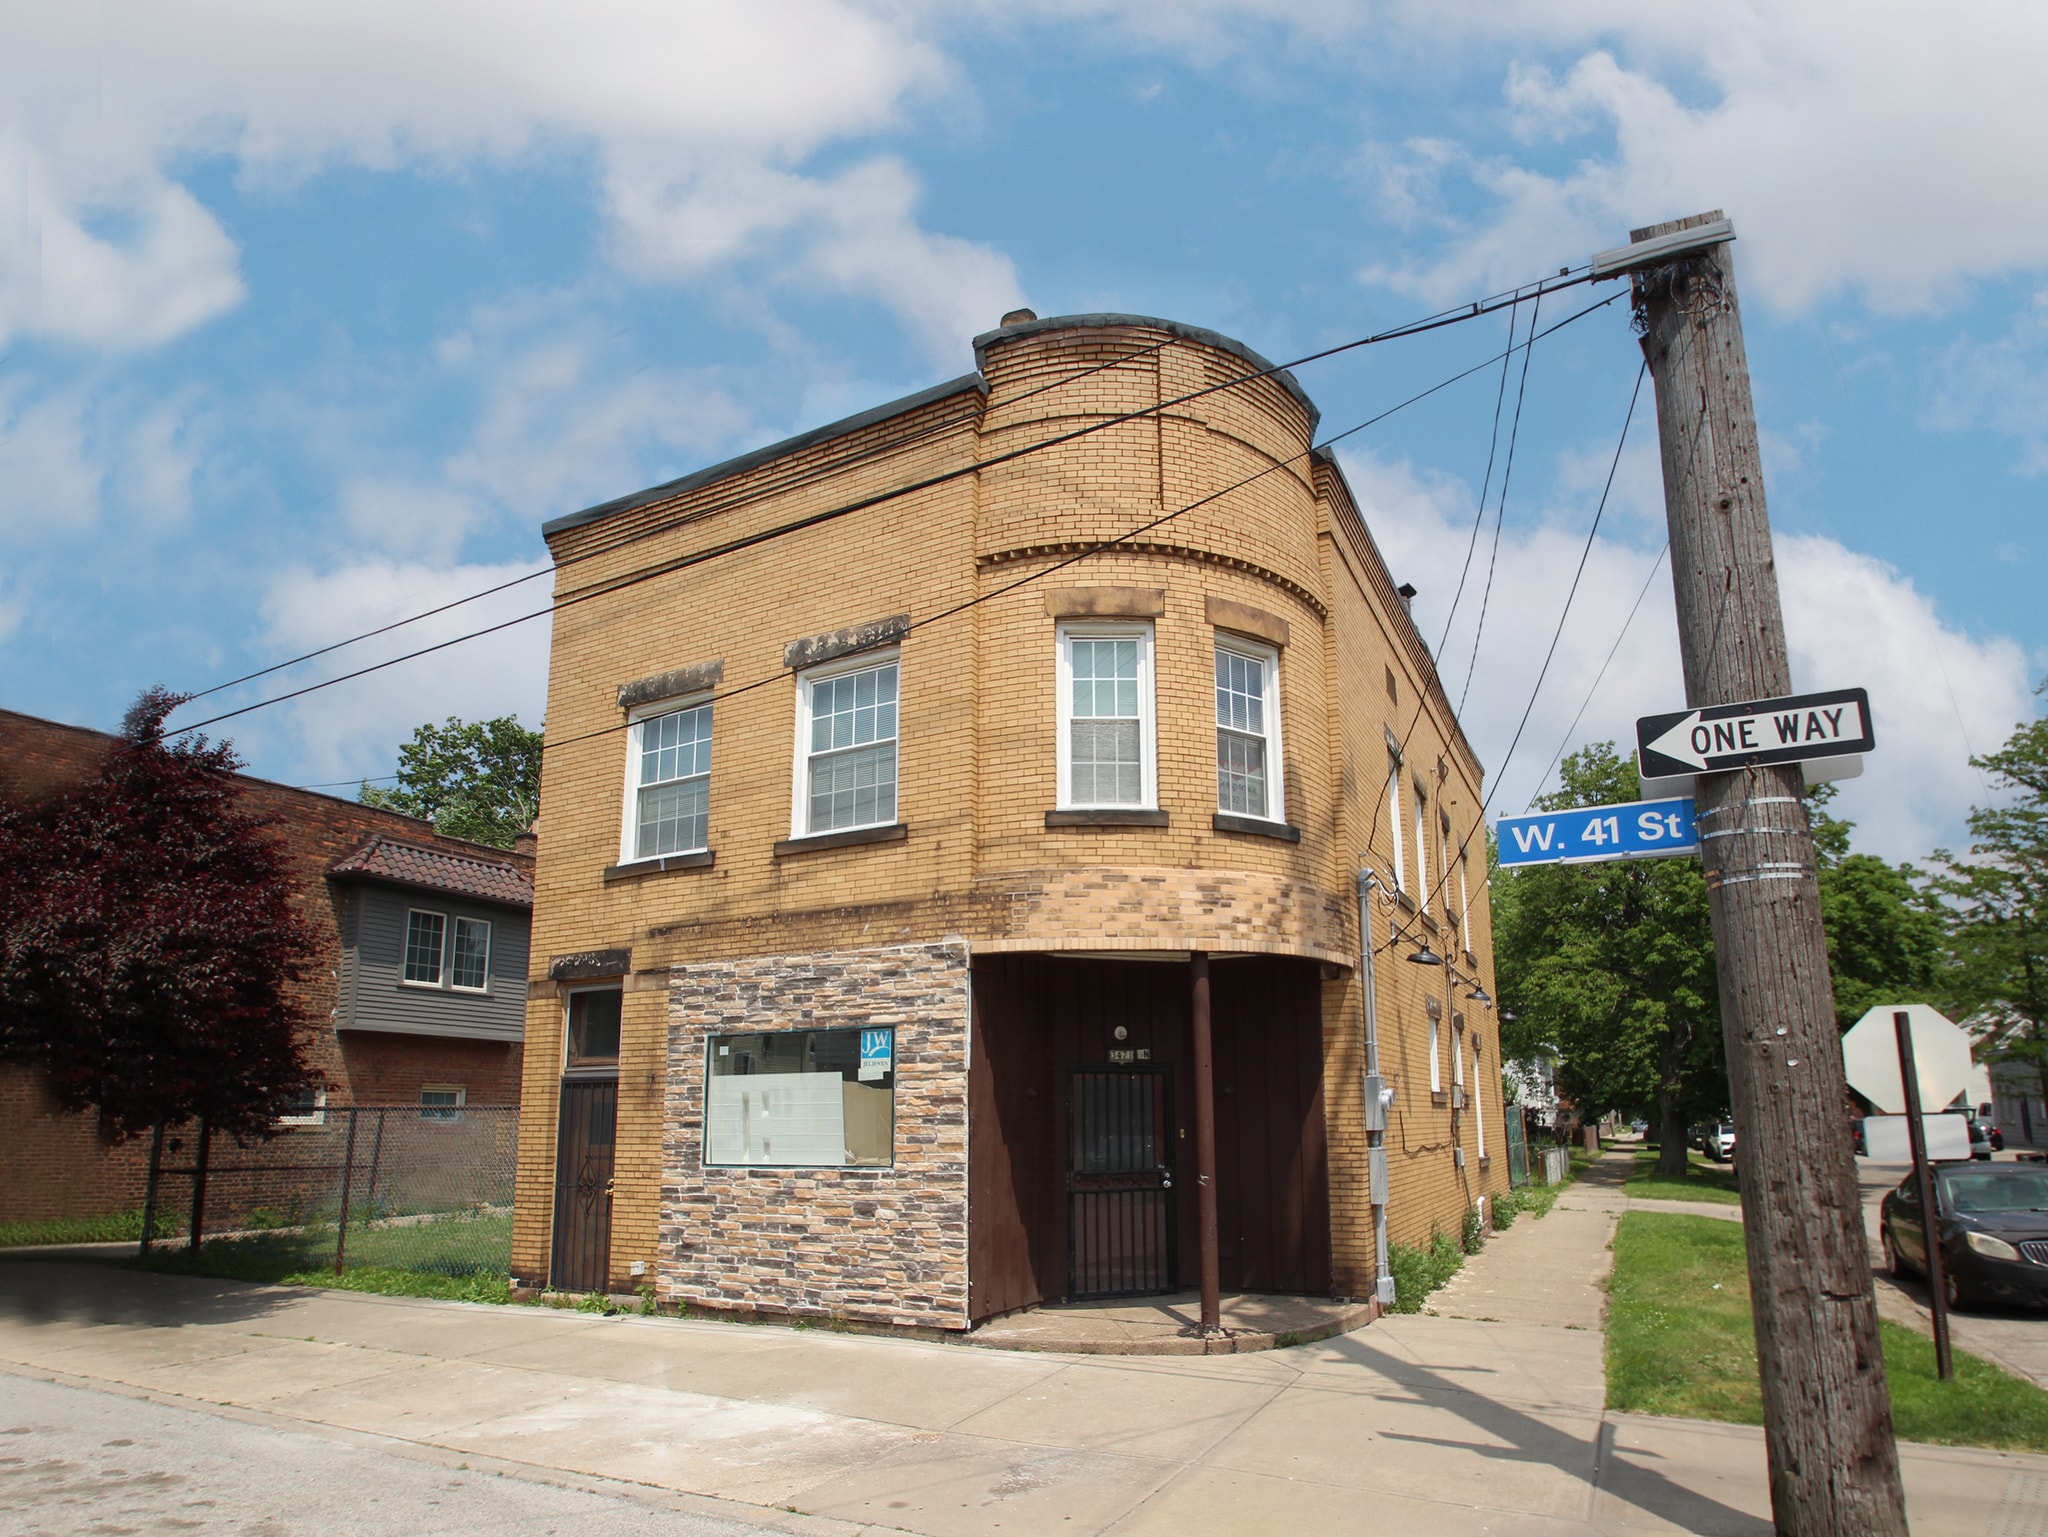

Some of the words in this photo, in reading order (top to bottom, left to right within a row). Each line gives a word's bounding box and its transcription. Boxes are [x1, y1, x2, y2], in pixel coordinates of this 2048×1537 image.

[1691, 719, 1759, 755] ONE
[1773, 707, 1844, 744] WAY
[1511, 823, 1565, 853] W.
[1581, 816, 1620, 846] 41
[1638, 811, 1682, 841] St
[862, 1032, 889, 1053] JW
